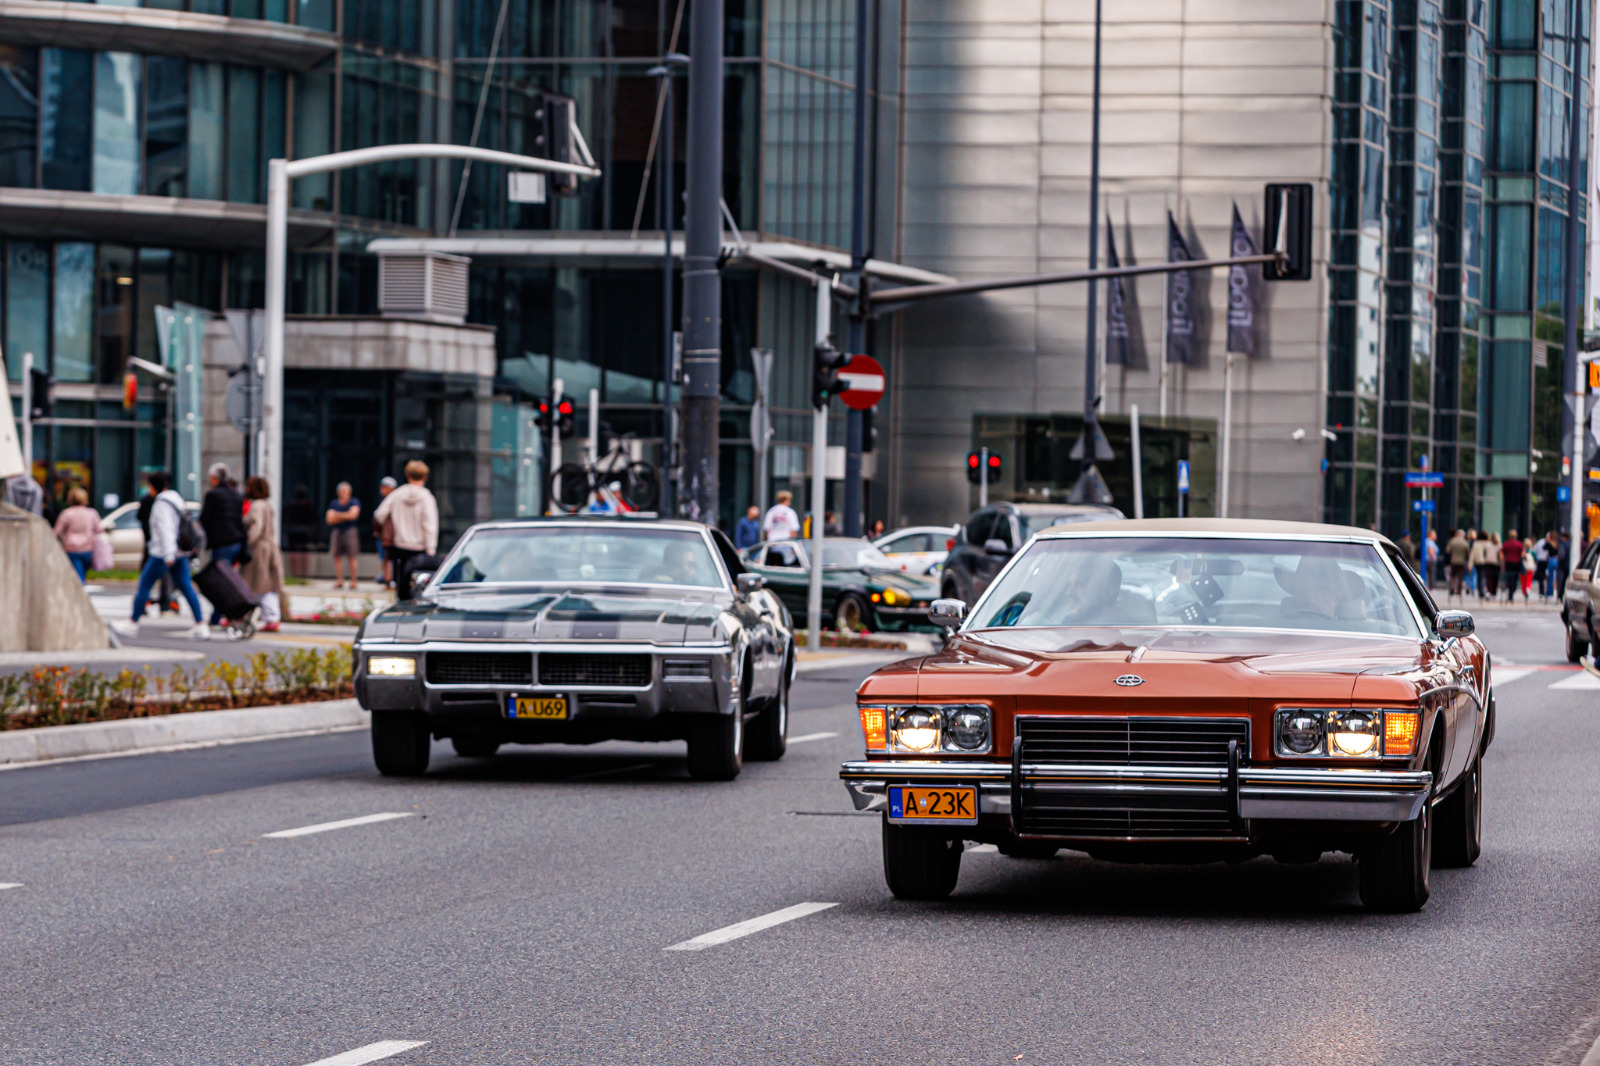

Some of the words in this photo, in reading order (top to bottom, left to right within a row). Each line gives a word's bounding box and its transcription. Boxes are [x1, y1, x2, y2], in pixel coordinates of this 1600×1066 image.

[518, 701, 528, 715] A
[533, 700, 564, 716] U69
[905, 791, 918, 815] A
[928, 791, 971, 815] 23K
